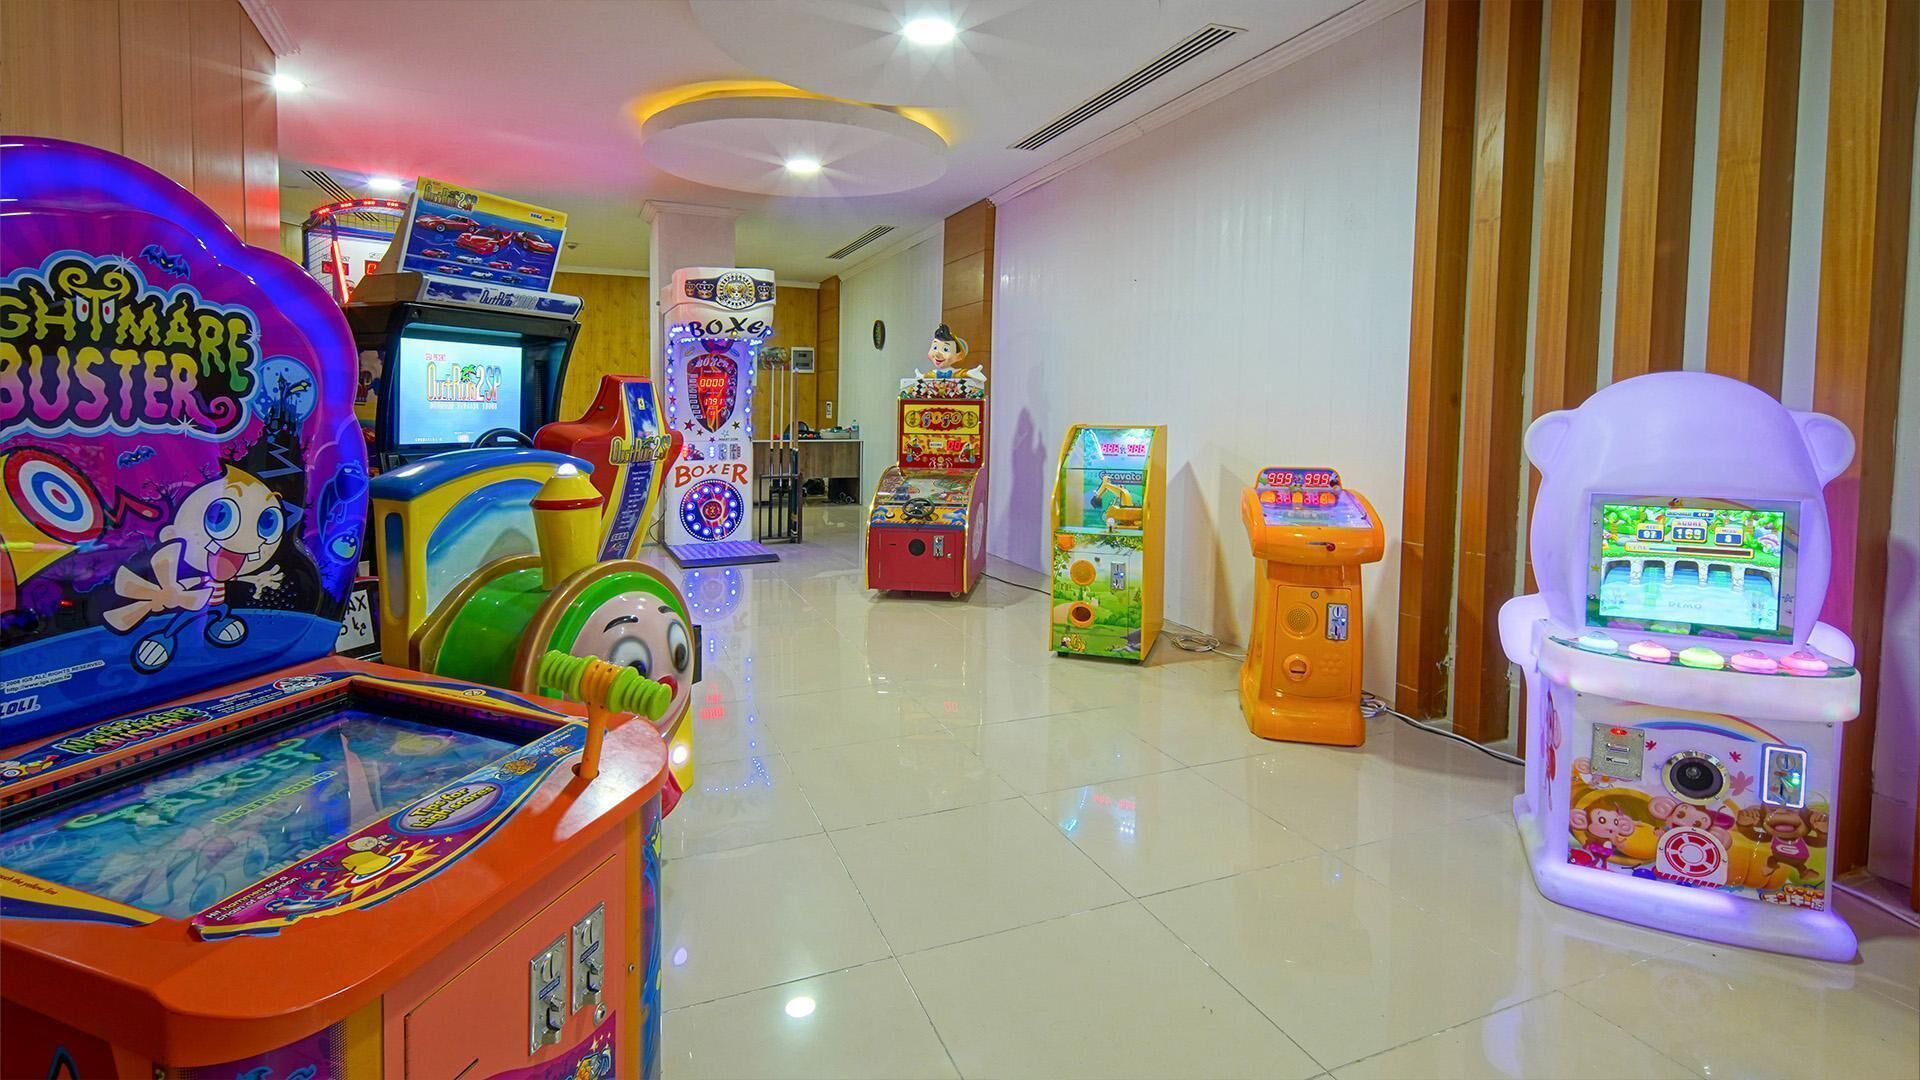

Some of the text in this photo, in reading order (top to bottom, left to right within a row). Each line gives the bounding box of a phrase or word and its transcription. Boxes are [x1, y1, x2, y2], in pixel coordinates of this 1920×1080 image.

[674, 463, 749, 488] BOXER
[34, 673, 46, 681] ALL
[47, 667, 71, 678] RIGHTS
[71, 661, 104, 672] RESERVED
[409, 788, 469, 816] Tips for
[410, 786, 496, 828] high scores
[205, 910, 222, 919] Hit
[221, 887, 267, 911] hammers
[265, 880, 279, 889] for
[216, 905, 246, 921] chain
[246, 899, 256, 907] of
